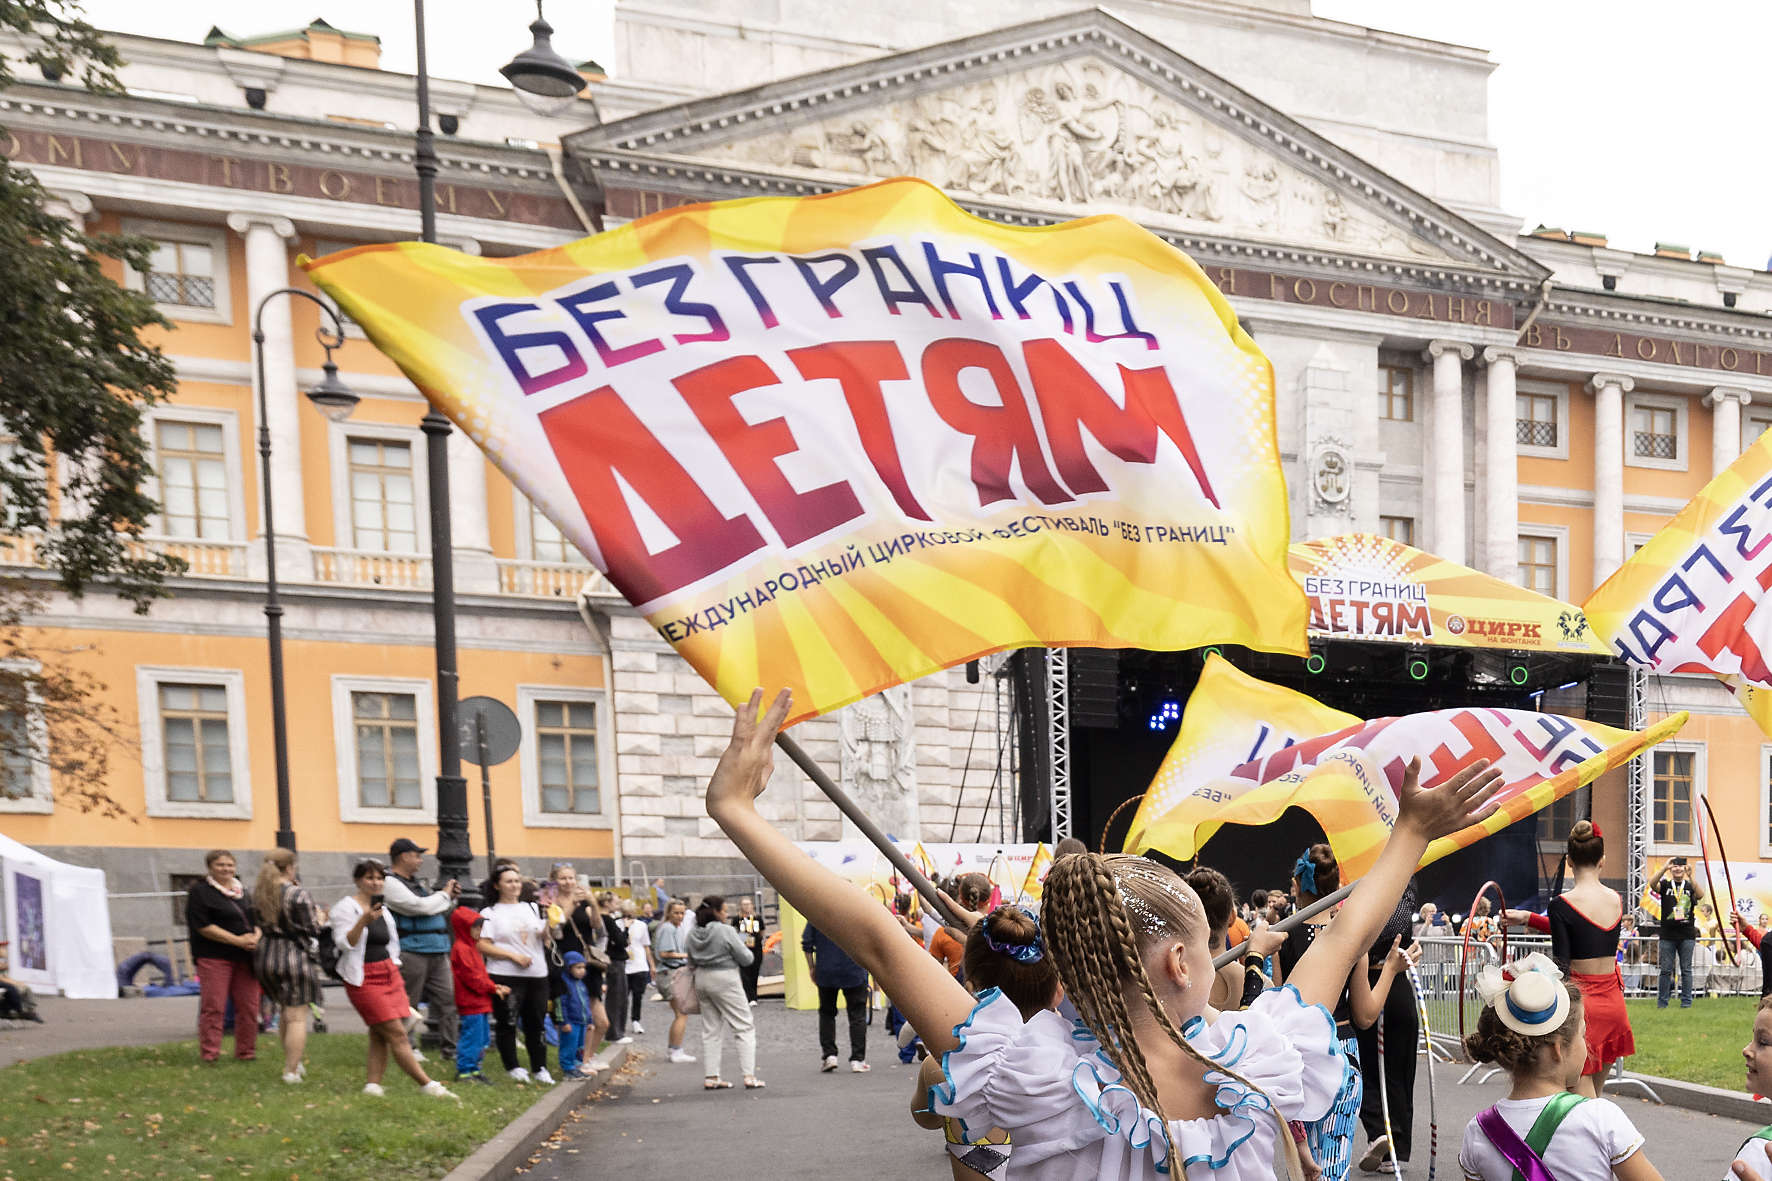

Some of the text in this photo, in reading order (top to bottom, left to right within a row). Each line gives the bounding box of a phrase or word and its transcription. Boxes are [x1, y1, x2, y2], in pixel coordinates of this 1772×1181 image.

[473, 241, 1160, 396] БЕЗ ГРАНИЦ
[1270, 272, 1492, 326] ГОСПОДНЯ
[538, 337, 1221, 607] ДЕТЯМ
[868, 528, 990, 563] ЦИРКОВОЙ
[992, 515, 1109, 538] ФЕСТИВАЛЬ
[1306, 577, 1426, 603] БЕЗ ГРАНИЦ
[1308, 595, 1432, 636] ДЕТЯМ
[1467, 619, 1541, 637] ЦИРК
[1500, 636, 1541, 646] ФОНТАНКЕ
